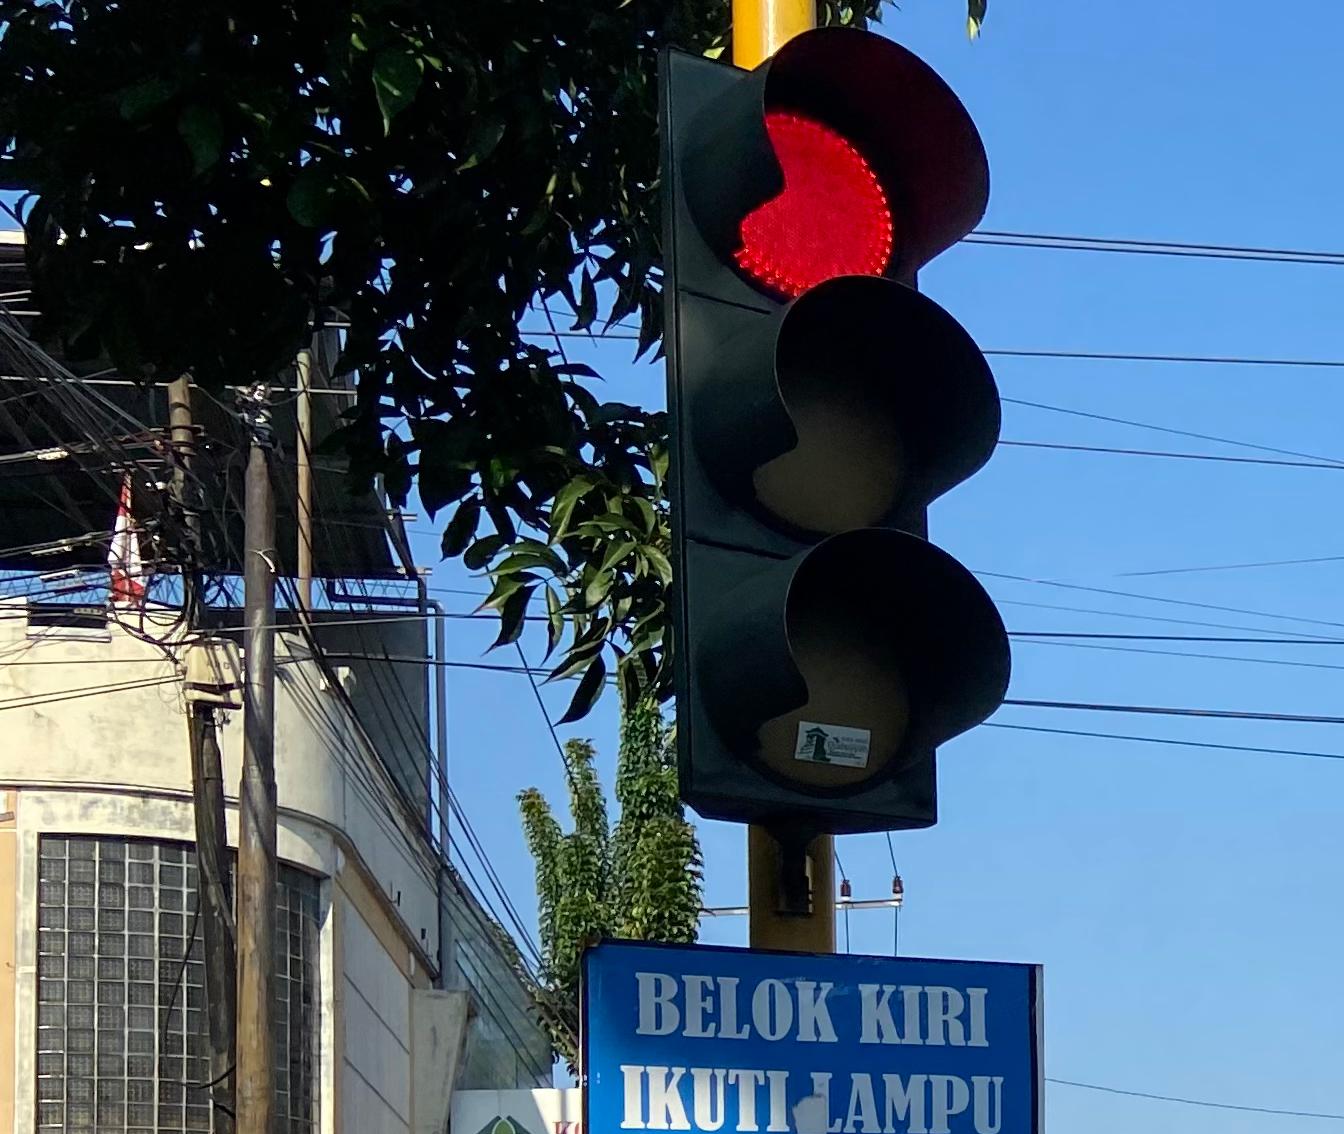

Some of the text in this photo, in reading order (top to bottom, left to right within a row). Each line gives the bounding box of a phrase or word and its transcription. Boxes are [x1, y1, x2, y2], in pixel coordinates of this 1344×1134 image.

[635, 971, 990, 1047] BELOK KIRI
[620, 1065, 790, 1133] IKUTI
